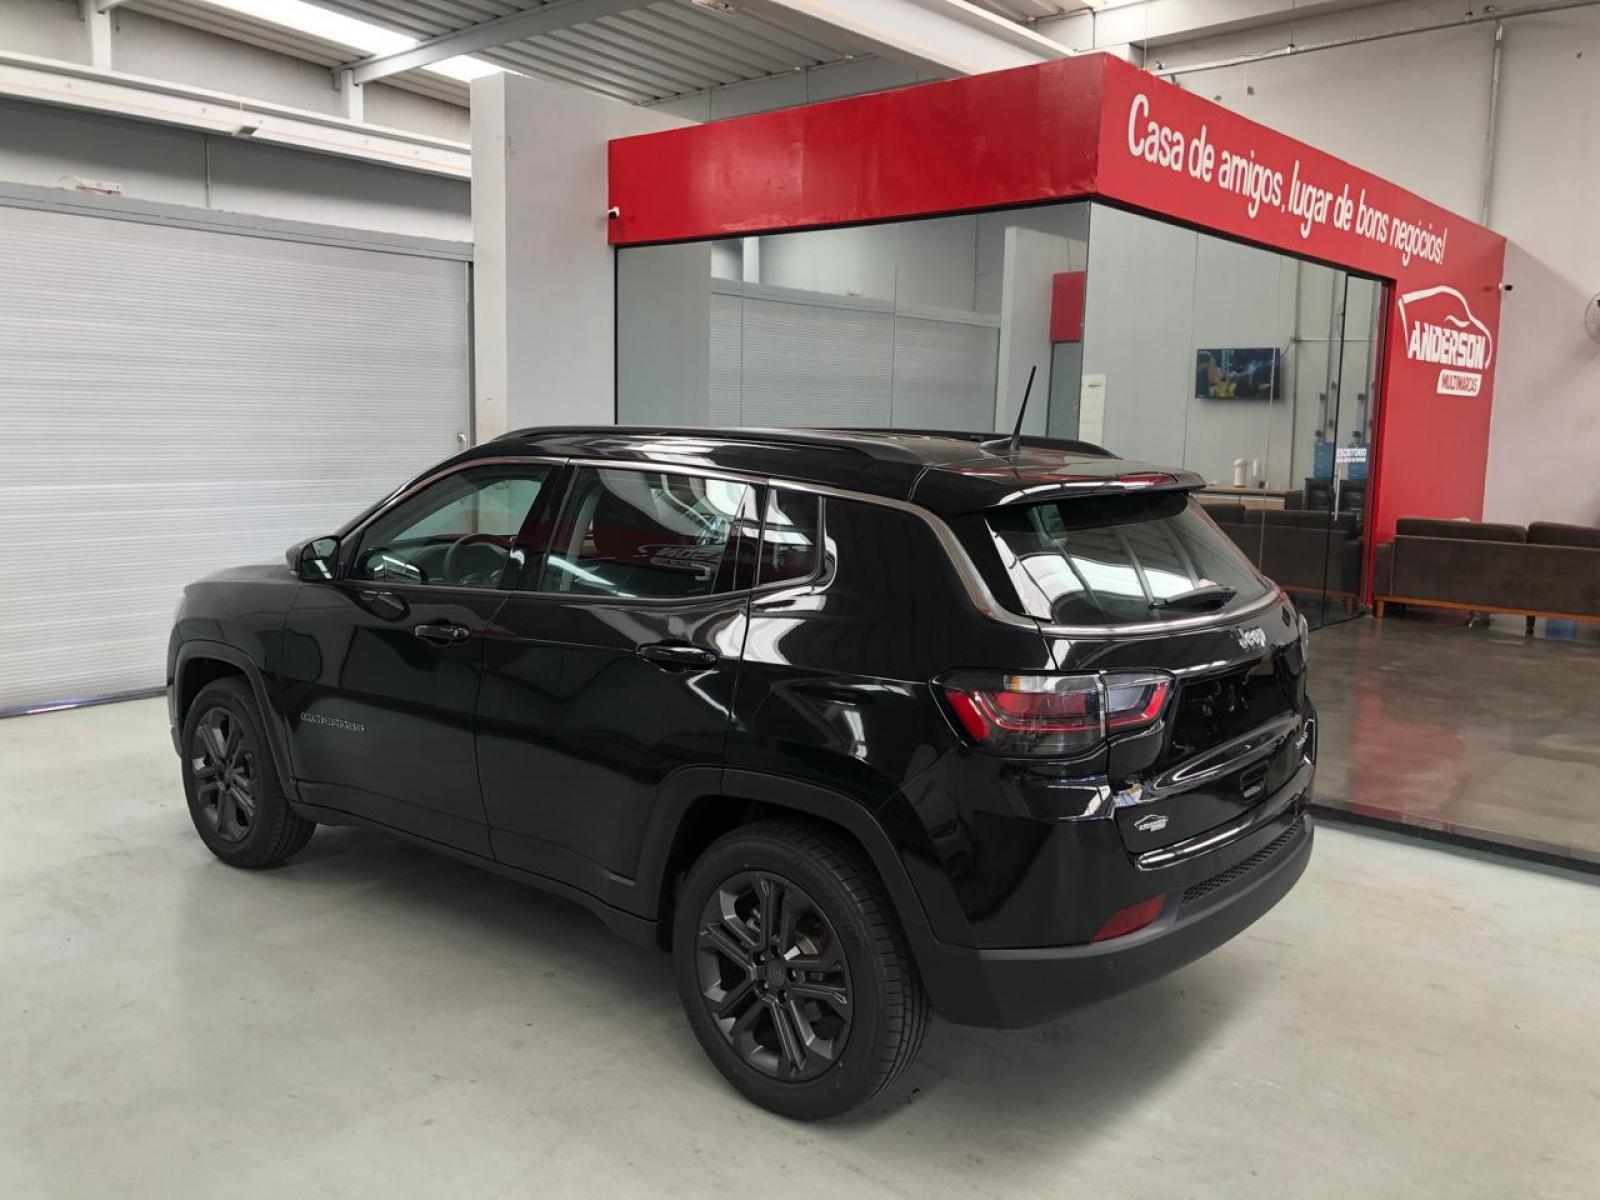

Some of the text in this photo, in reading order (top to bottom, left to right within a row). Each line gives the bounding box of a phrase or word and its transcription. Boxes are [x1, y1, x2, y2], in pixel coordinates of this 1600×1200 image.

[1128, 93, 1448, 267] Casa de amigos, lugar de bons negócios!
[1407, 319, 1486, 370] ANDERSON
